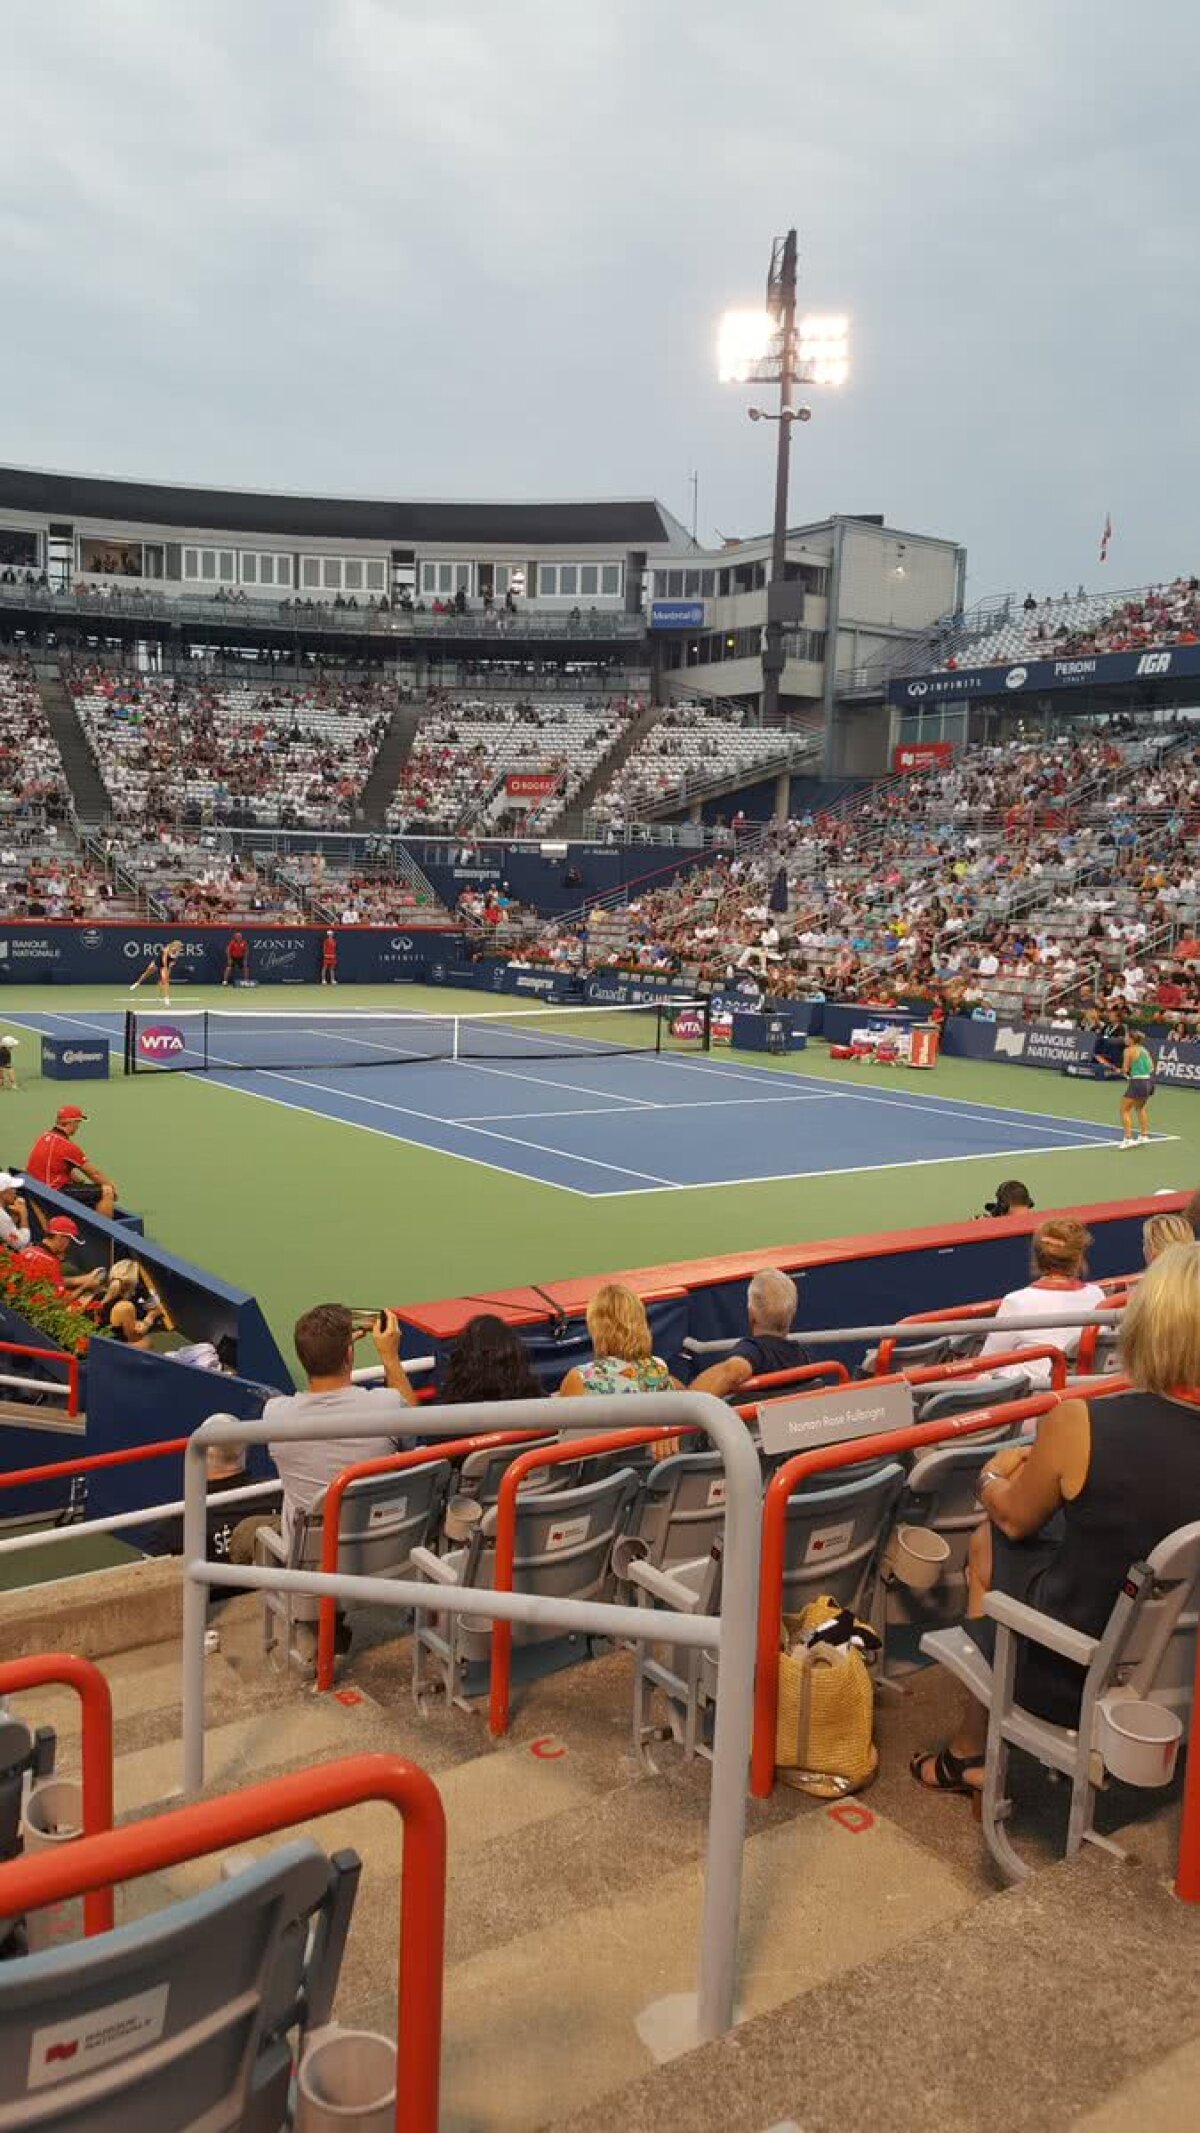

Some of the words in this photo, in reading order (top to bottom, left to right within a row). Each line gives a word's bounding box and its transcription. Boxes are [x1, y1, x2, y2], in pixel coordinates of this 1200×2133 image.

[1054, 659, 1096, 675] PERONI
[1136, 653, 1173, 674] IGA
[143, 943, 204, 956] ROERS
[253, 939, 305, 949] ZONIN
[674, 1022, 701, 1033] WTA
[141, 1035, 184, 1049] WTA
[1030, 1033, 1077, 1048] BANQUE
[1027, 1046, 1090, 1061] NATIONALE
[1159, 1044, 1178, 1061] LA
[788, 1419, 822, 1433] Norton
[822, 1415, 845, 1427] Rose
[826, 1804, 876, 1834] D
